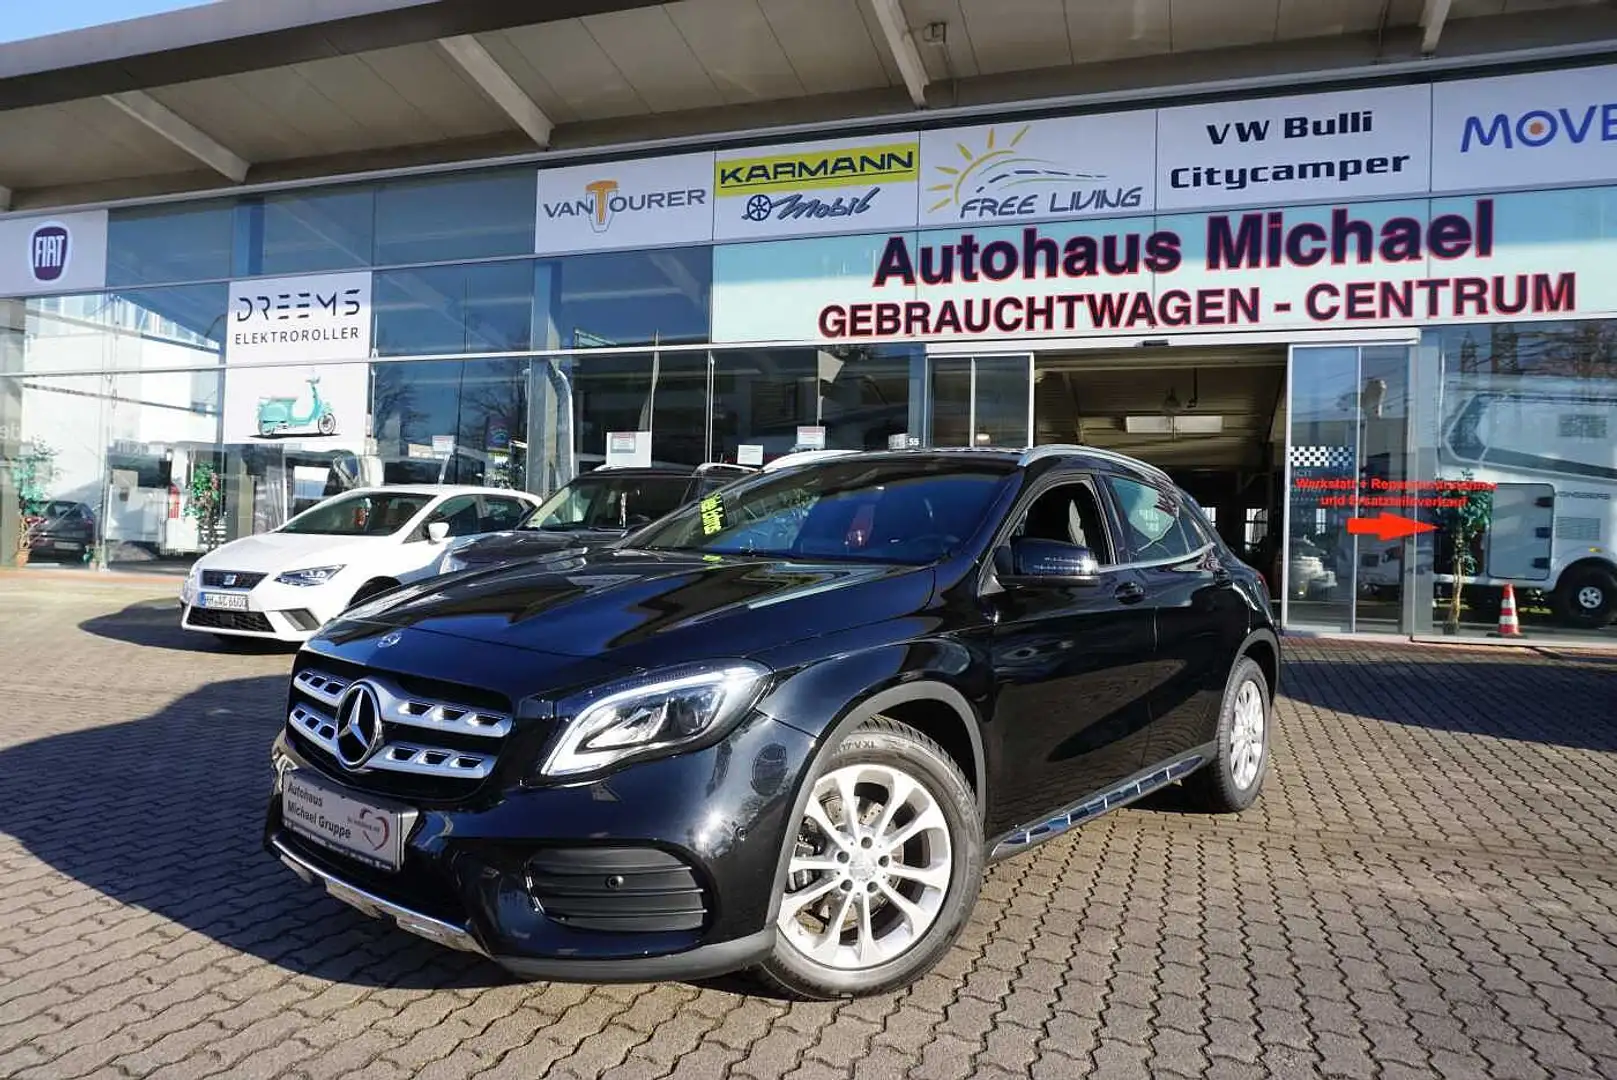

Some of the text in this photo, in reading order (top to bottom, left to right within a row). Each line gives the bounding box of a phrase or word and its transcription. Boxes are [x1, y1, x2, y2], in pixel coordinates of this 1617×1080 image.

[1207, 111, 1373, 145] VW Bulli
[720, 150, 914, 186] KARMANN
[1170, 155, 1410, 191] Citycamper
[543, 179, 706, 226] VANTOURER
[771, 187, 881, 222] Mobil
[960, 186, 1142, 219] FREE LIVING
[34, 235, 65, 268] FIAT
[873, 199, 1494, 288] Autohaus Michael
[236, 289, 360, 323] DREEMS
[818, 286, 1260, 338] GEBRAUCHTWAGEN
[1304, 271, 1577, 321] CENTRUM
[235, 326, 360, 346] ELEKTROROLLER
[287, 783, 323, 807] Autohaus
[287, 800, 318, 825] Michael
[319, 815, 352, 839] Gruppe
